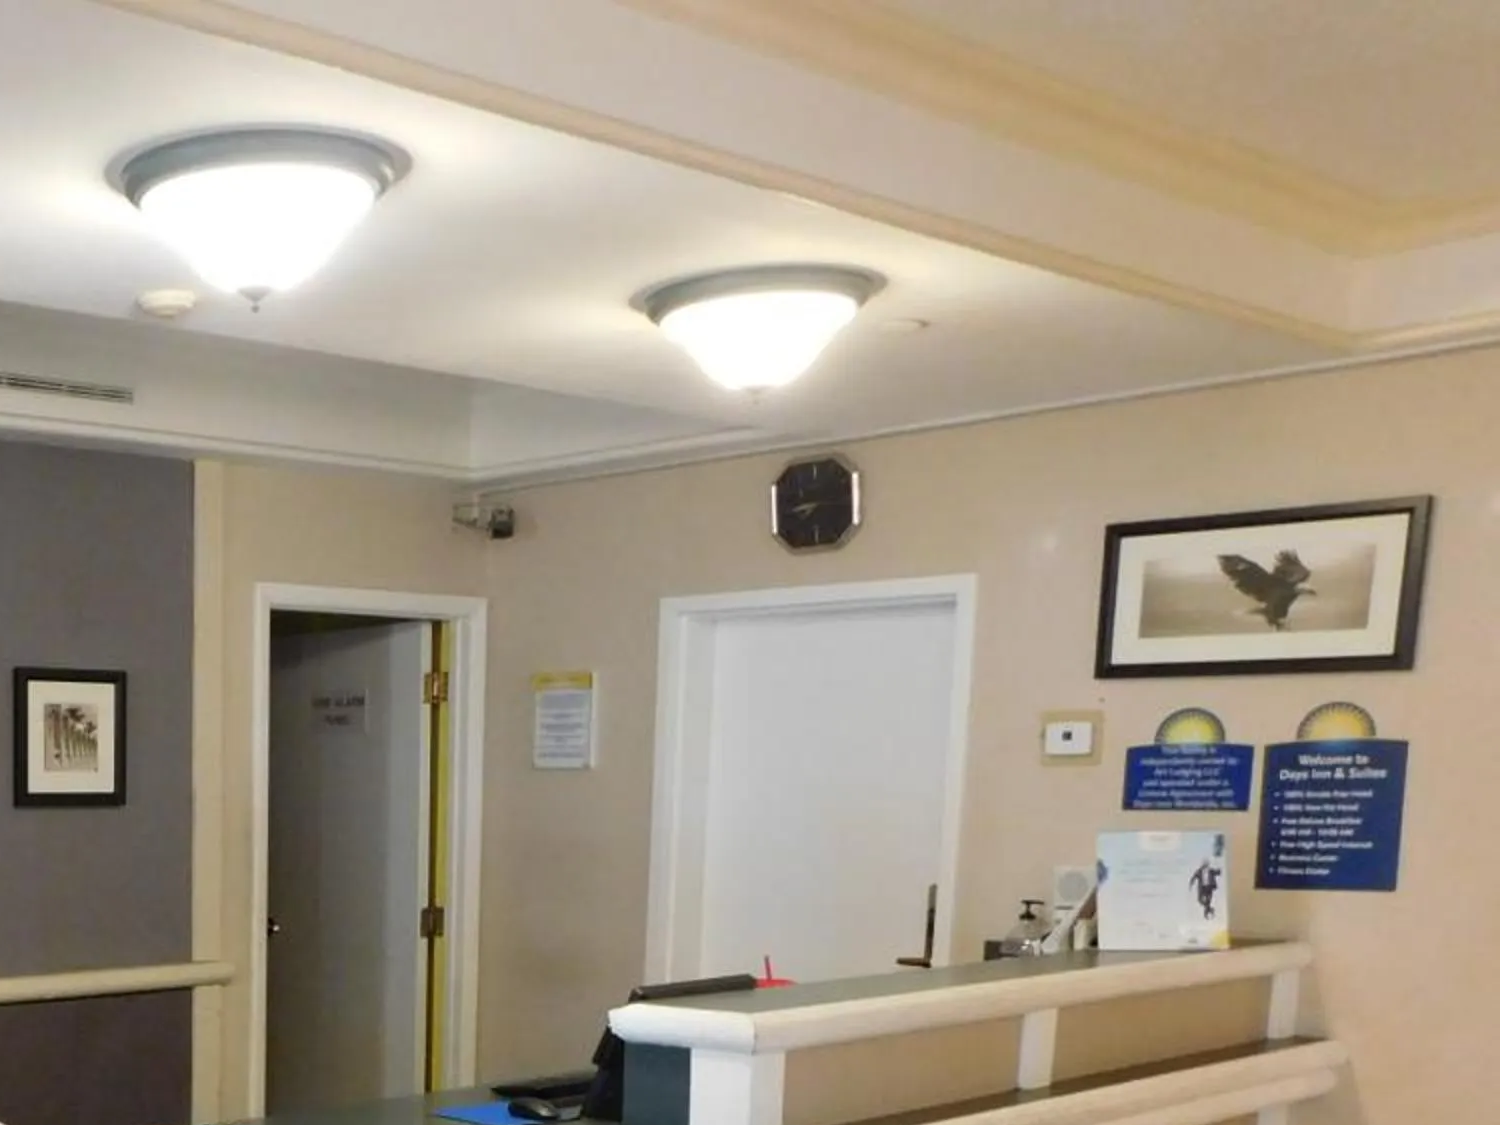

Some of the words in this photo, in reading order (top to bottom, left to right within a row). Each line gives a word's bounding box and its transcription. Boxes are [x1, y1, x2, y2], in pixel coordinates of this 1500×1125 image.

[1298, 754, 1353, 766] Welcome
[1355, 753, 1370, 765] to
[1279, 769, 1308, 783] Days
[1311, 768, 1332, 779] Inn
[1333, 767, 1345, 779] &
